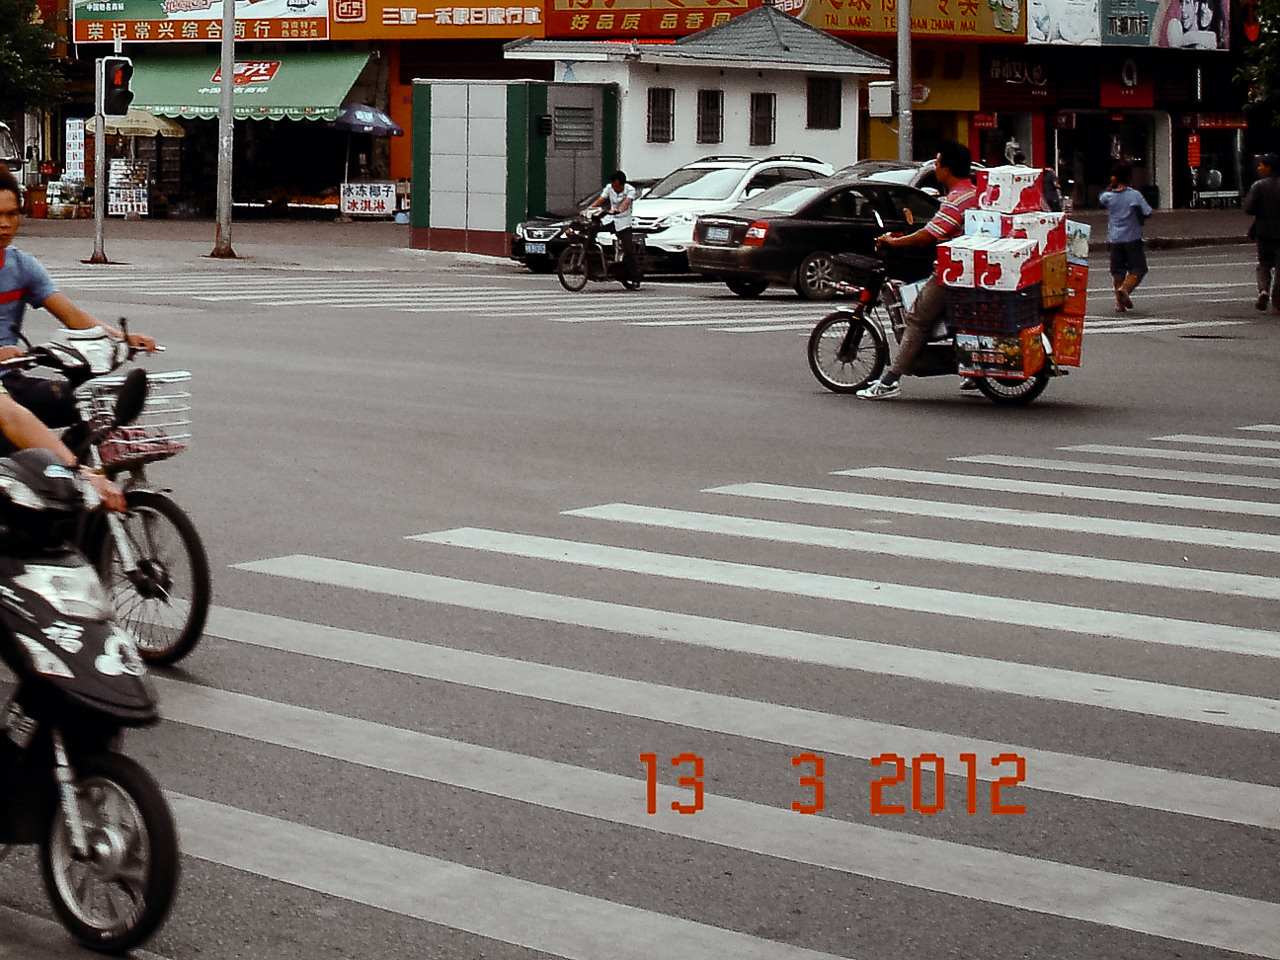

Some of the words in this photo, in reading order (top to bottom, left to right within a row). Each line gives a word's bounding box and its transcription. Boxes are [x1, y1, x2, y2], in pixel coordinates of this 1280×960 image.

[570, 13, 641, 30] 好品质
[824, 14, 839, 26] TAI
[848, 15, 871, 27] KANG
[87, 21, 271, 39] 荣记常兴综合商行
[347, 199, 386, 212] 冰淇淋
